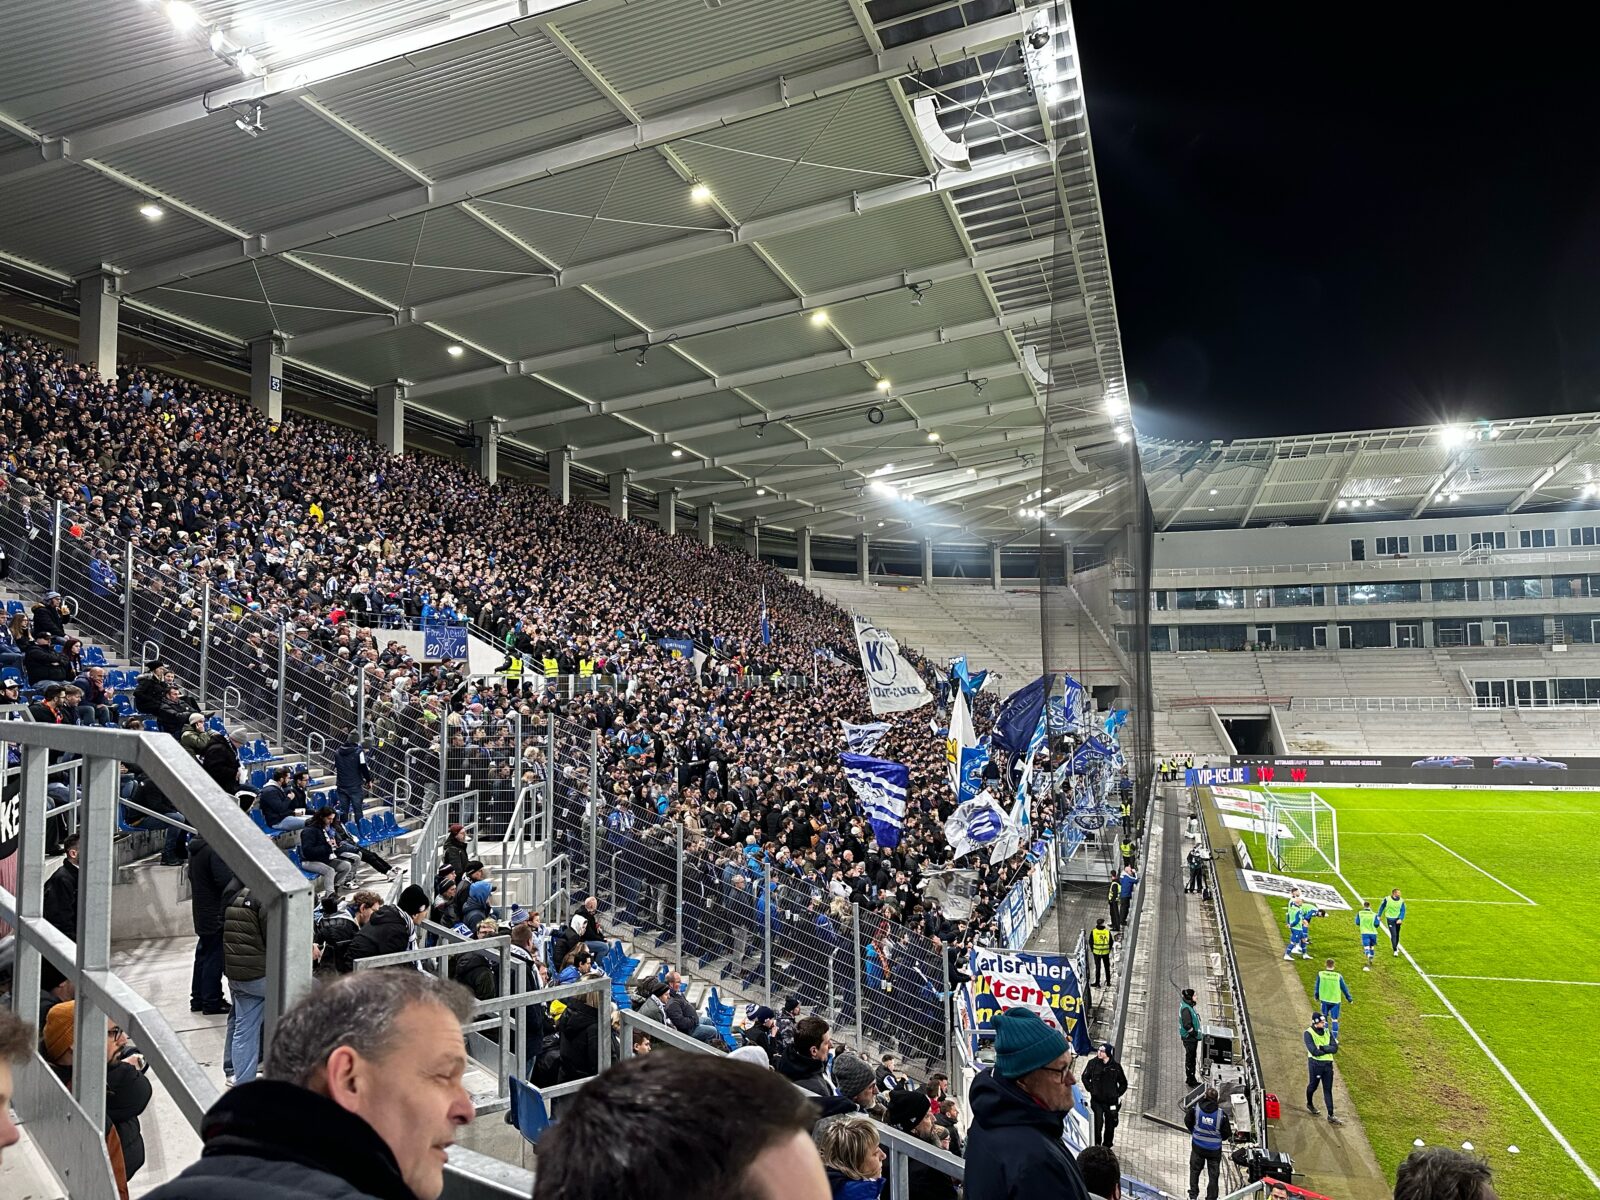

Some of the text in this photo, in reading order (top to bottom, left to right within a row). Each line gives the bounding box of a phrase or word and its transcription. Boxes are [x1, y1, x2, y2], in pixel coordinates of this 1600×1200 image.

[1198, 767, 1244, 785] VIP-KSC.DE
[977, 953, 1070, 979] arlsruher
[976, 975, 1083, 1014] llterrier
